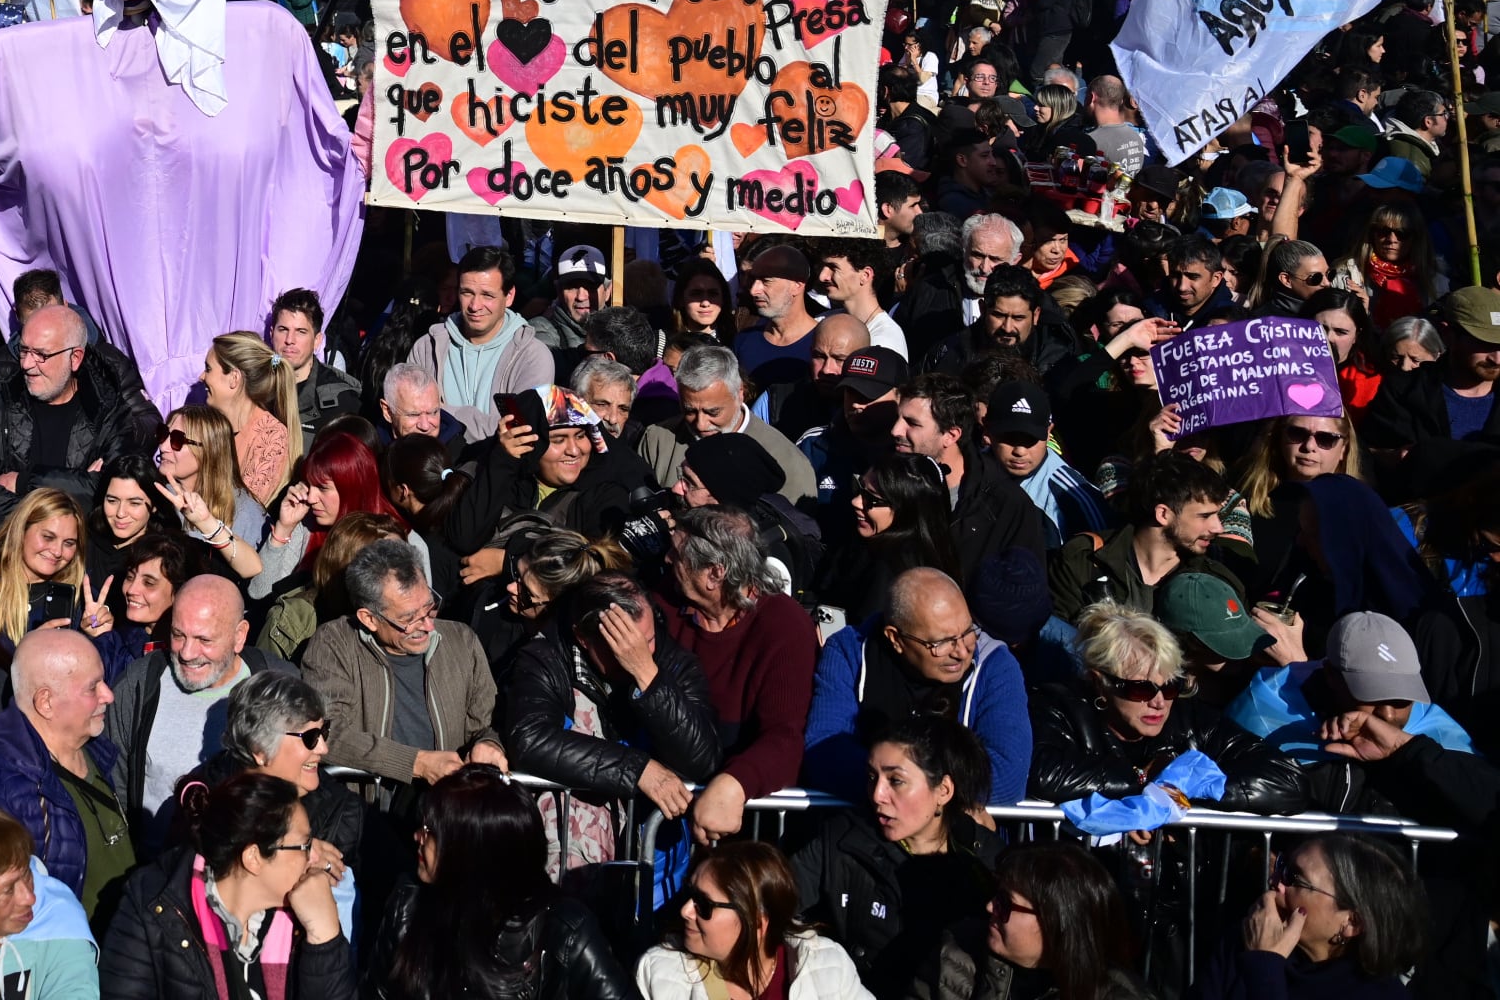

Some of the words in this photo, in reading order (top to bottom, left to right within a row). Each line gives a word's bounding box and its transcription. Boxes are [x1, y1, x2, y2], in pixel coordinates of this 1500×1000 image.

[386, 30, 437, 68] en
[451, 3, 486, 72] el
[573, 9, 640, 74] del
[668, 21, 778, 89] pueblo
[808, 35, 843, 92] al
[387, 81, 442, 137] que
[466, 75, 630, 140] hiciste
[655, 90, 737, 143] muy
[759, 88, 858, 154] feliz
[401, 146, 460, 194] Por
[486, 139, 574, 202] doce
[584, 154, 677, 201] años
[684, 172, 715, 218] y
[726, 162, 839, 217] medio
[851, 358, 875, 369] RUSTY
[1180, 350, 1254, 377] ESTAMOS
[1263, 347, 1291, 359] CON
[1302, 343, 1331, 358] VOS
[1200, 373, 1218, 388] DE
